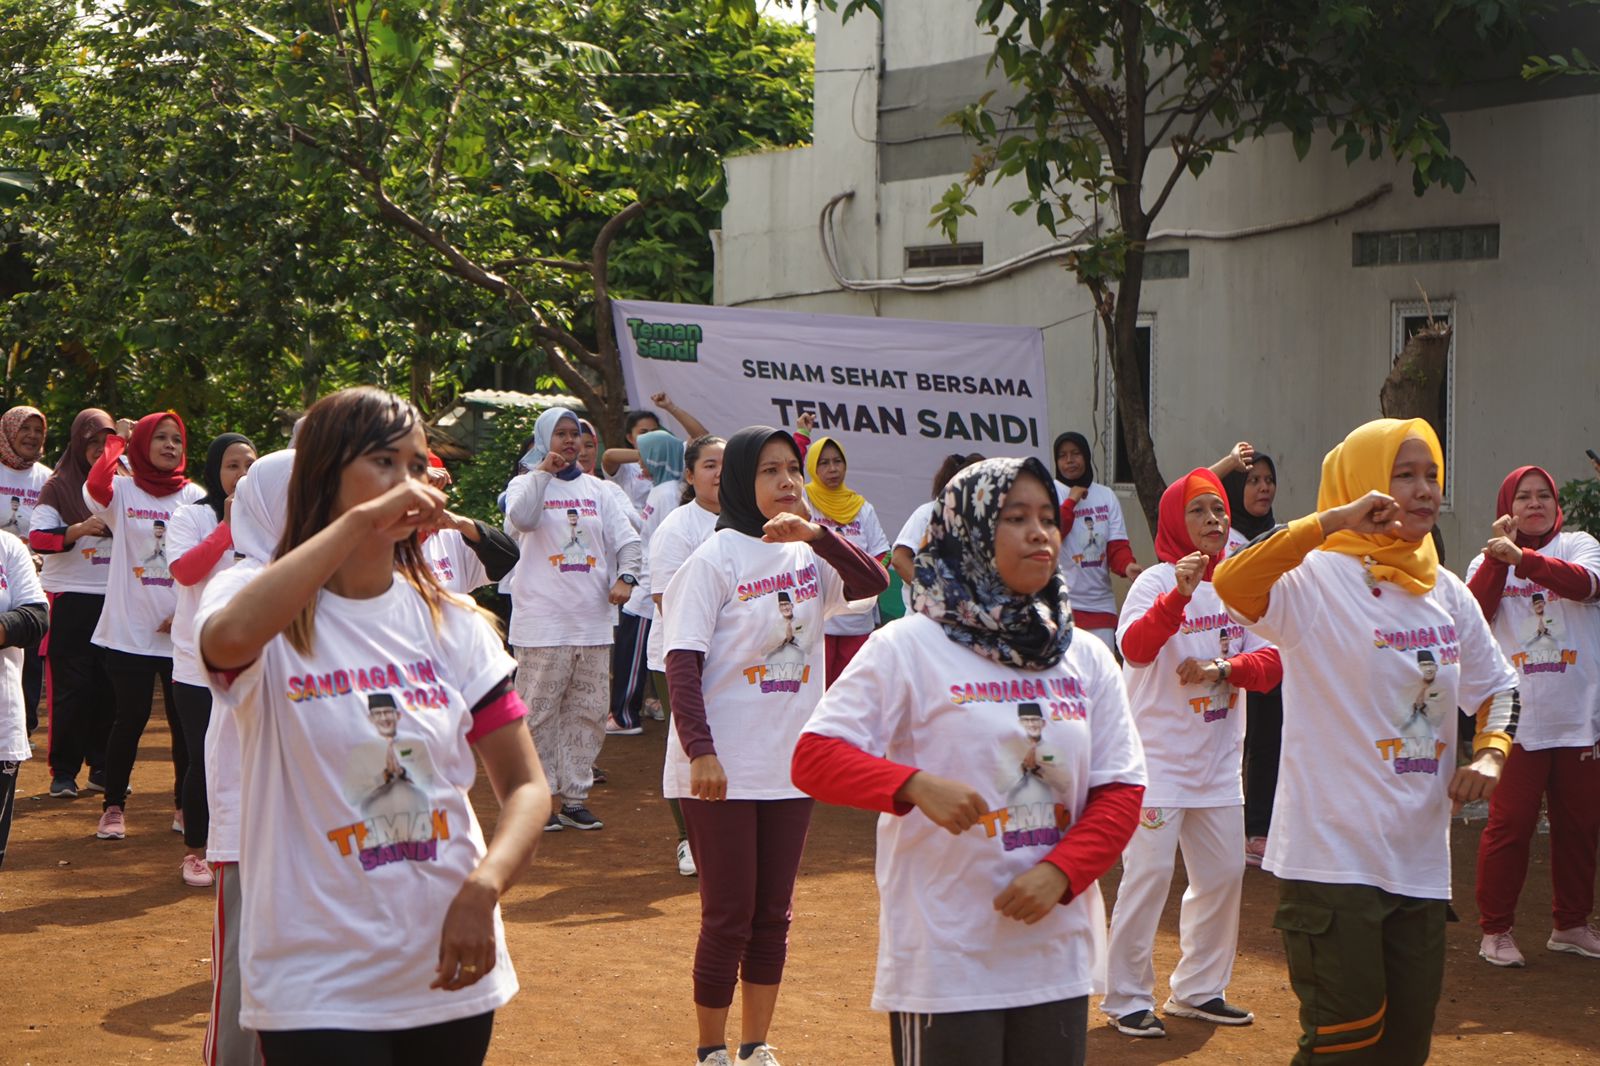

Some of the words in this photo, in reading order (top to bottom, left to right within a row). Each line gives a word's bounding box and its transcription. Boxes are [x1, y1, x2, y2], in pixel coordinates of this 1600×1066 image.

[627, 318, 703, 343] Teman
[636, 337, 698, 362] Sandi
[742, 359, 825, 384] SENAM
[830, 366, 909, 390] SEHAT
[916, 373, 1033, 398] BERSAMA
[771, 398, 907, 436] TEMAN
[917, 409, 1040, 448] SANDI
[1374, 626, 1440, 651] SNDIAGA
[1438, 624, 1457, 644] UN
[287, 663, 404, 703] SANDIAGA
[403, 659, 437, 686] UN
[949, 678, 1049, 705] SANDIAGA
[402, 685, 449, 711] 2024
[1050, 701, 1087, 721] 2024
[359, 838, 438, 871] SANDI
